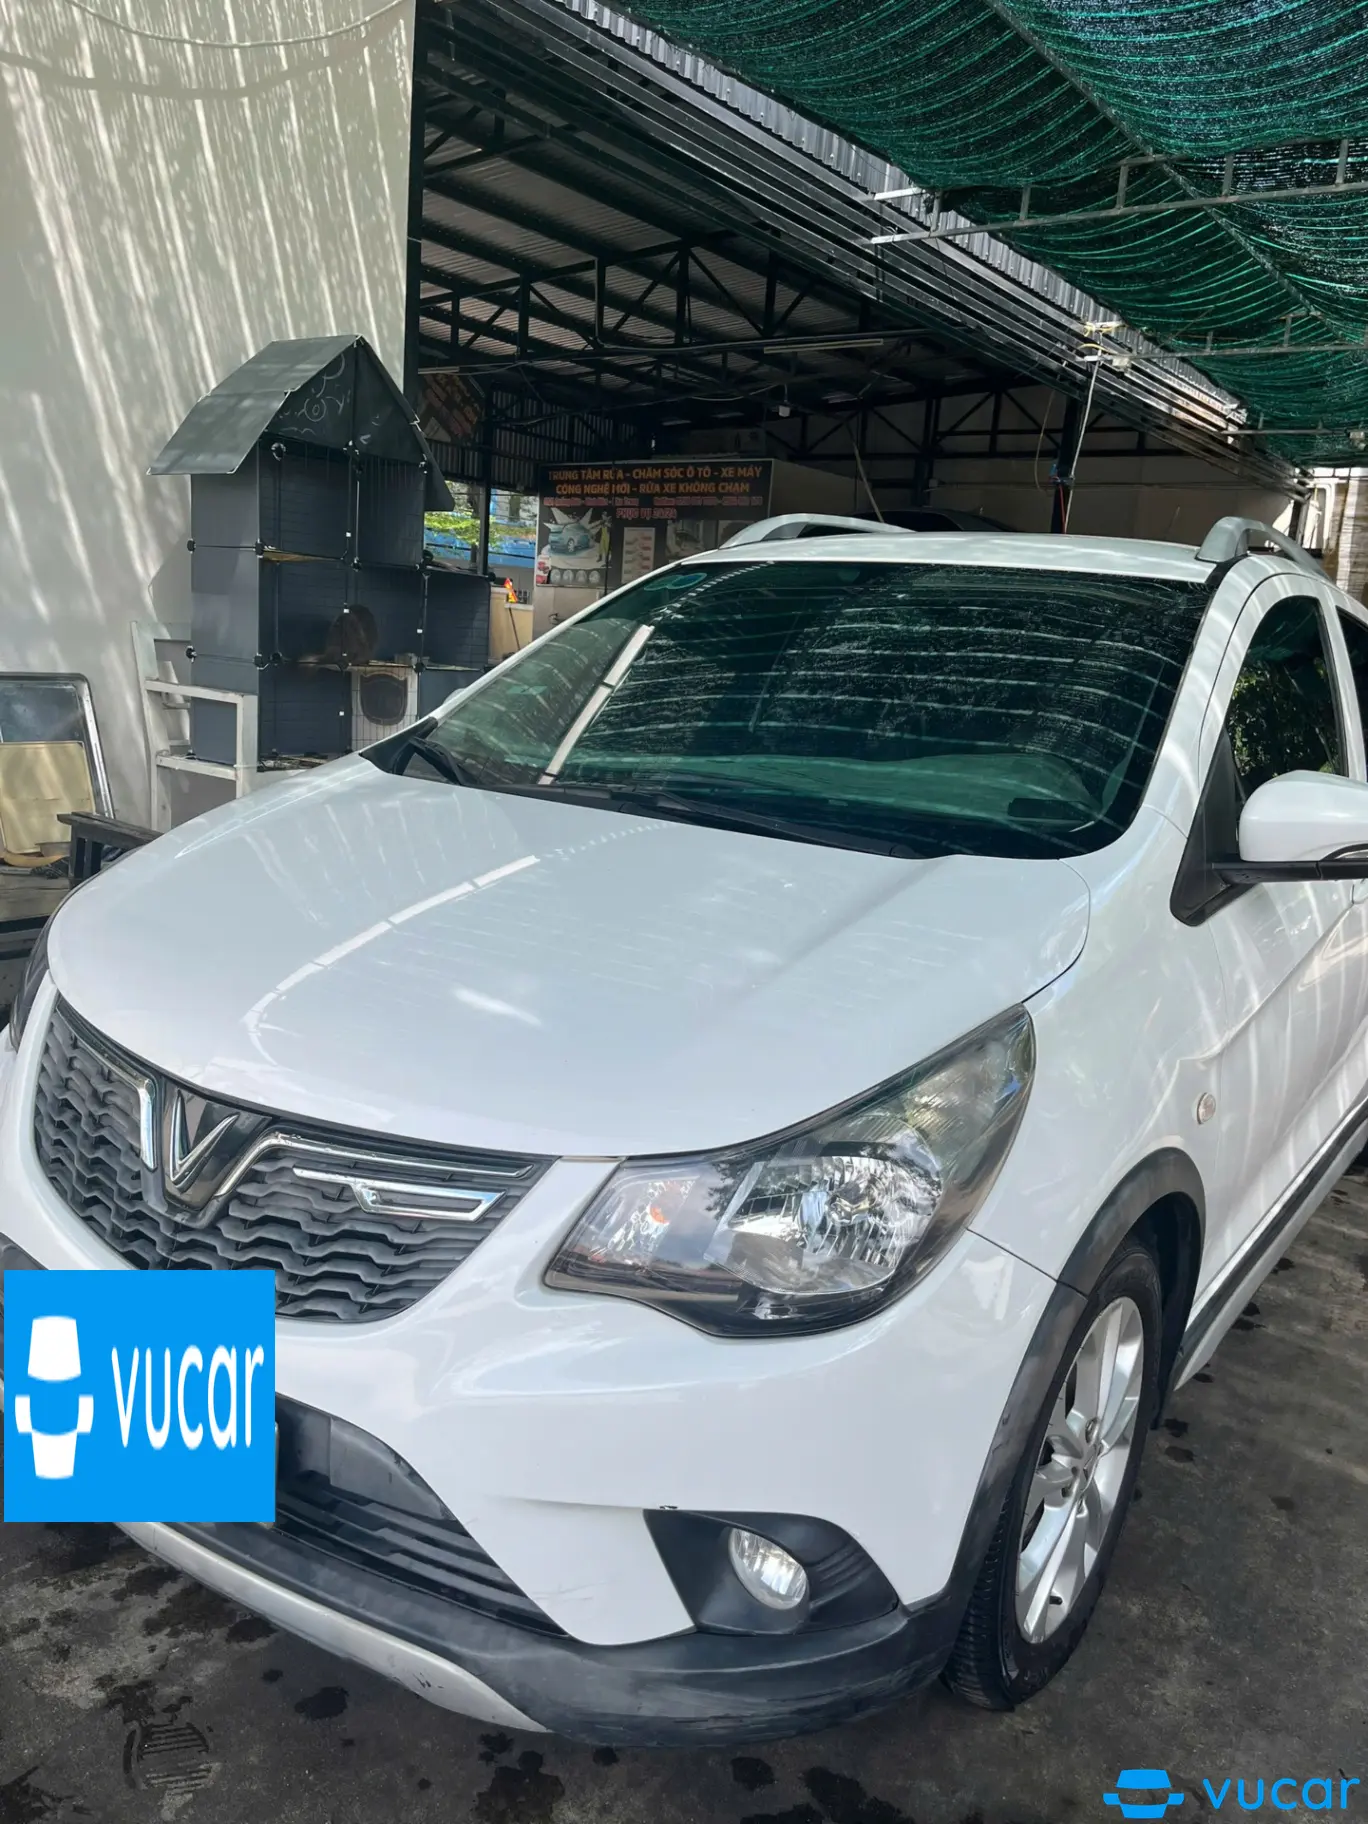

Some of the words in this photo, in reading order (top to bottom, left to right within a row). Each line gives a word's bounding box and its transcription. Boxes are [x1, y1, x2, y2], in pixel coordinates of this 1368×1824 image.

[549, 470, 579, 480] TRUNG
[581, 467, 601, 480] TÂM
[632, 466, 661, 479] CHĂM
[697, 465, 712, 478] TÔ
[721, 467, 735, 478] XE
[737, 464, 762, 478] MÁY
[556, 482, 582, 494] CÔNG
[663, 483, 676, 493] XE
[678, 480, 716, 493] KHÔNG
